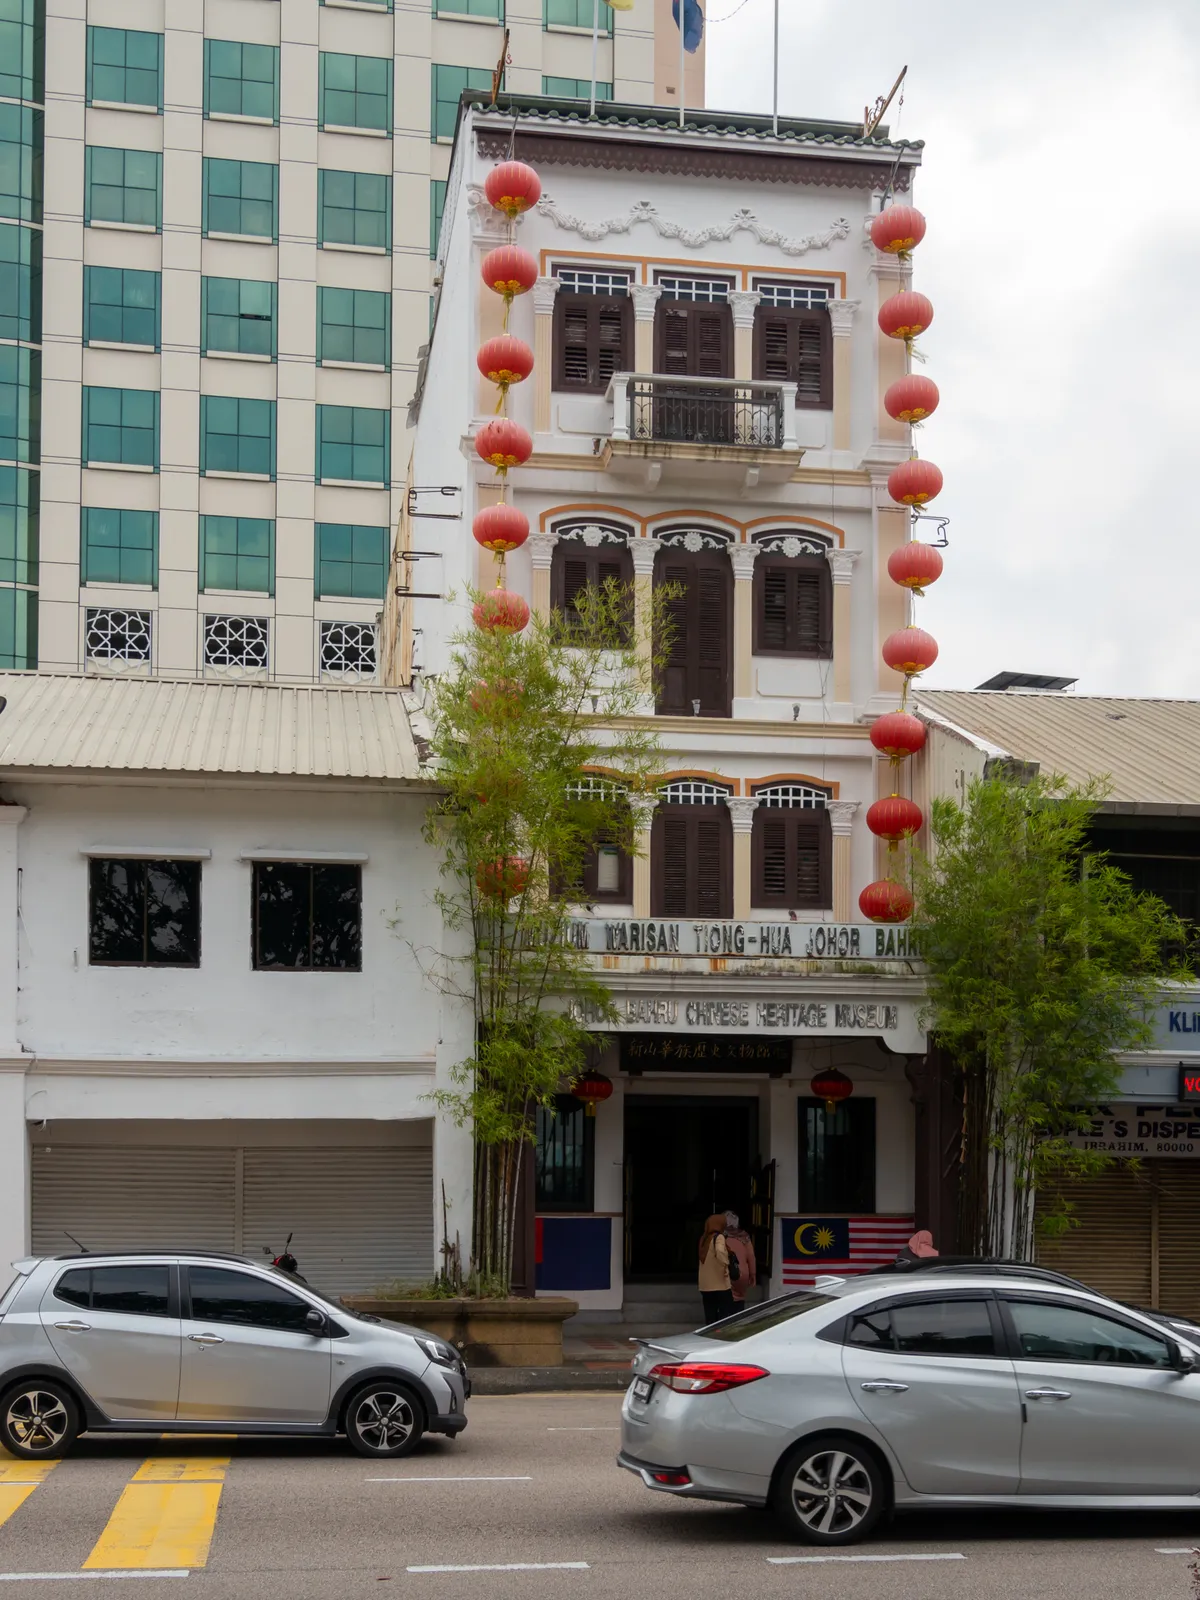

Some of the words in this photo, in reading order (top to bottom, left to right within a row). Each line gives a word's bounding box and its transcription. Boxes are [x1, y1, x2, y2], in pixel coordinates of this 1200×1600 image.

[605, 922, 680, 952] WARISAN
[693, 923, 792, 954] TIONG-HUA
[805, 926, 860, 956] JOHOR
[875, 928, 924, 956] BAHR
[625, 999, 679, 1025] BAHRU
[686, 1001, 749, 1027] CHINESE
[756, 1002, 828, 1028] HERITAGE
[835, 1003, 898, 1030] MUSEUM
[1156, 1142, 1194, 1153] 80000
